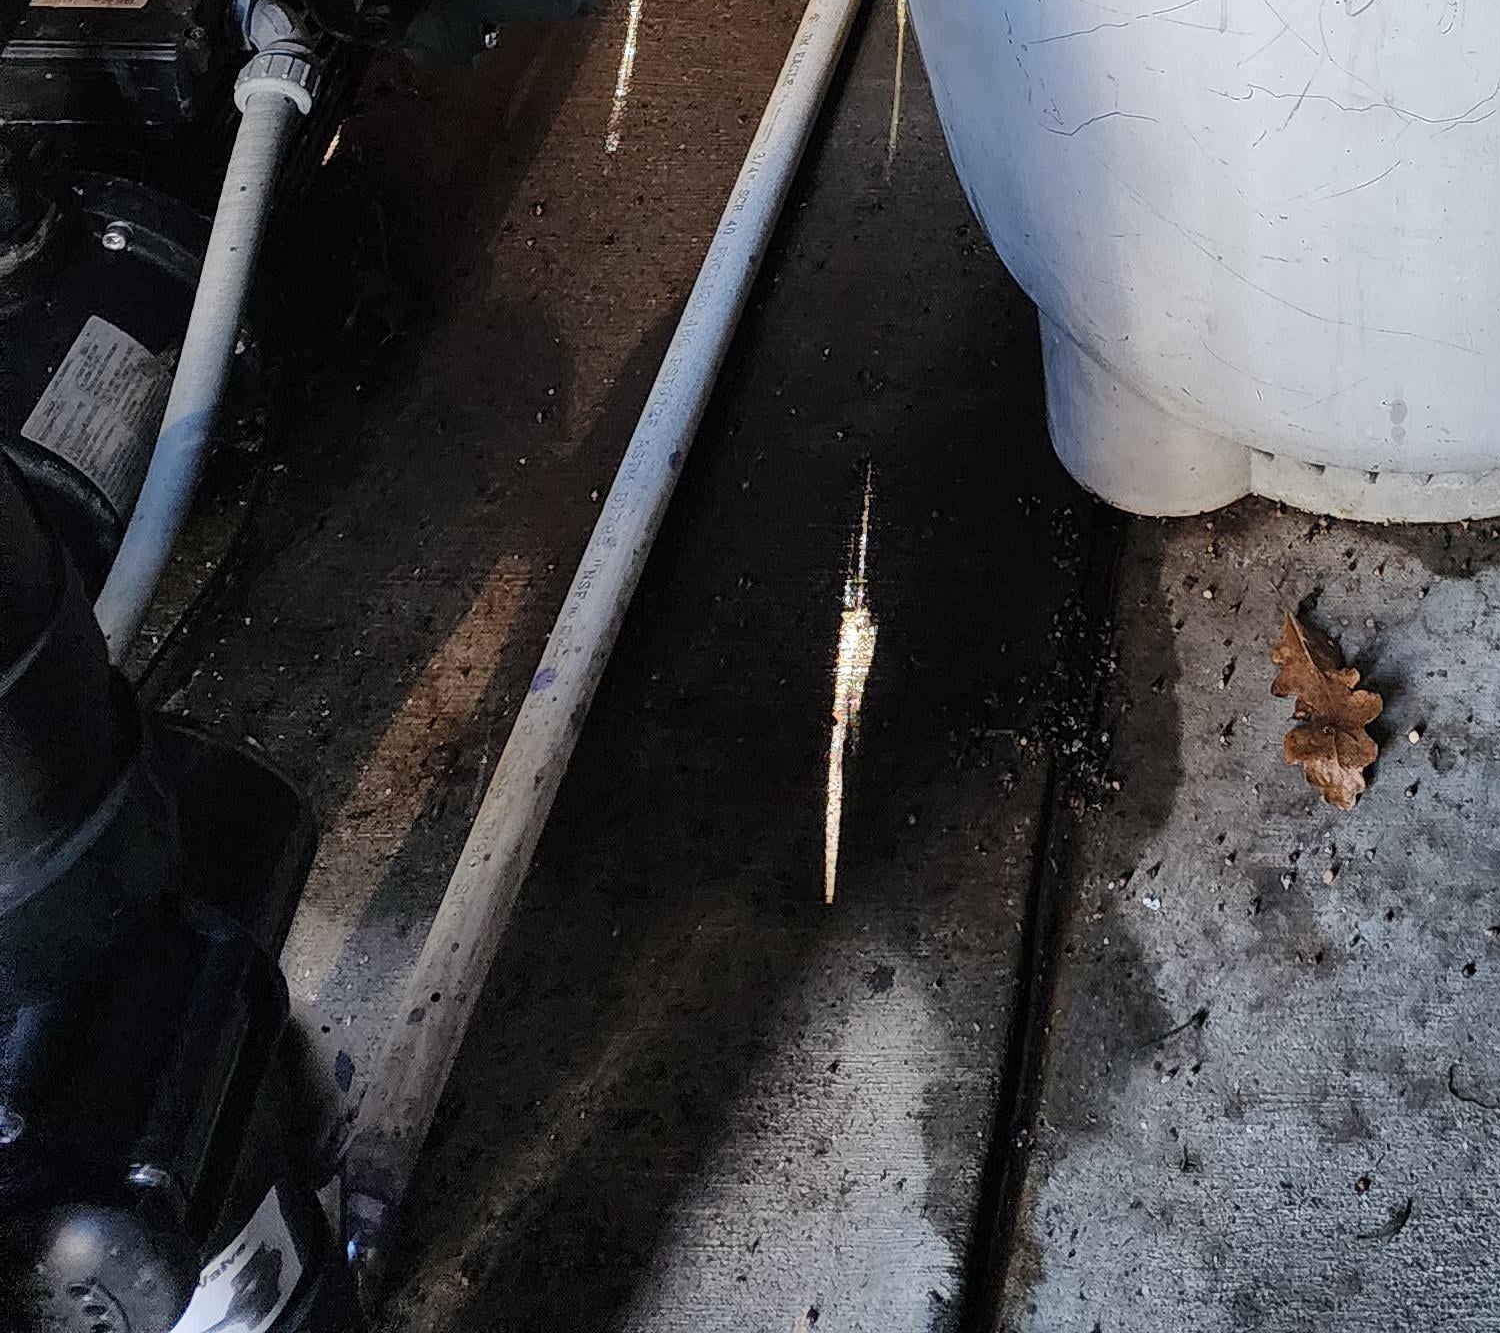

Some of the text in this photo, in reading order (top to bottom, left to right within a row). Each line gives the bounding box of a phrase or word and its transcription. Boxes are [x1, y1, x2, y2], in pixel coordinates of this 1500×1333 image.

[785, 51, 806, 86] EAGLE
[731, 189, 750, 212] SCH
[722, 219, 736, 236] 40
